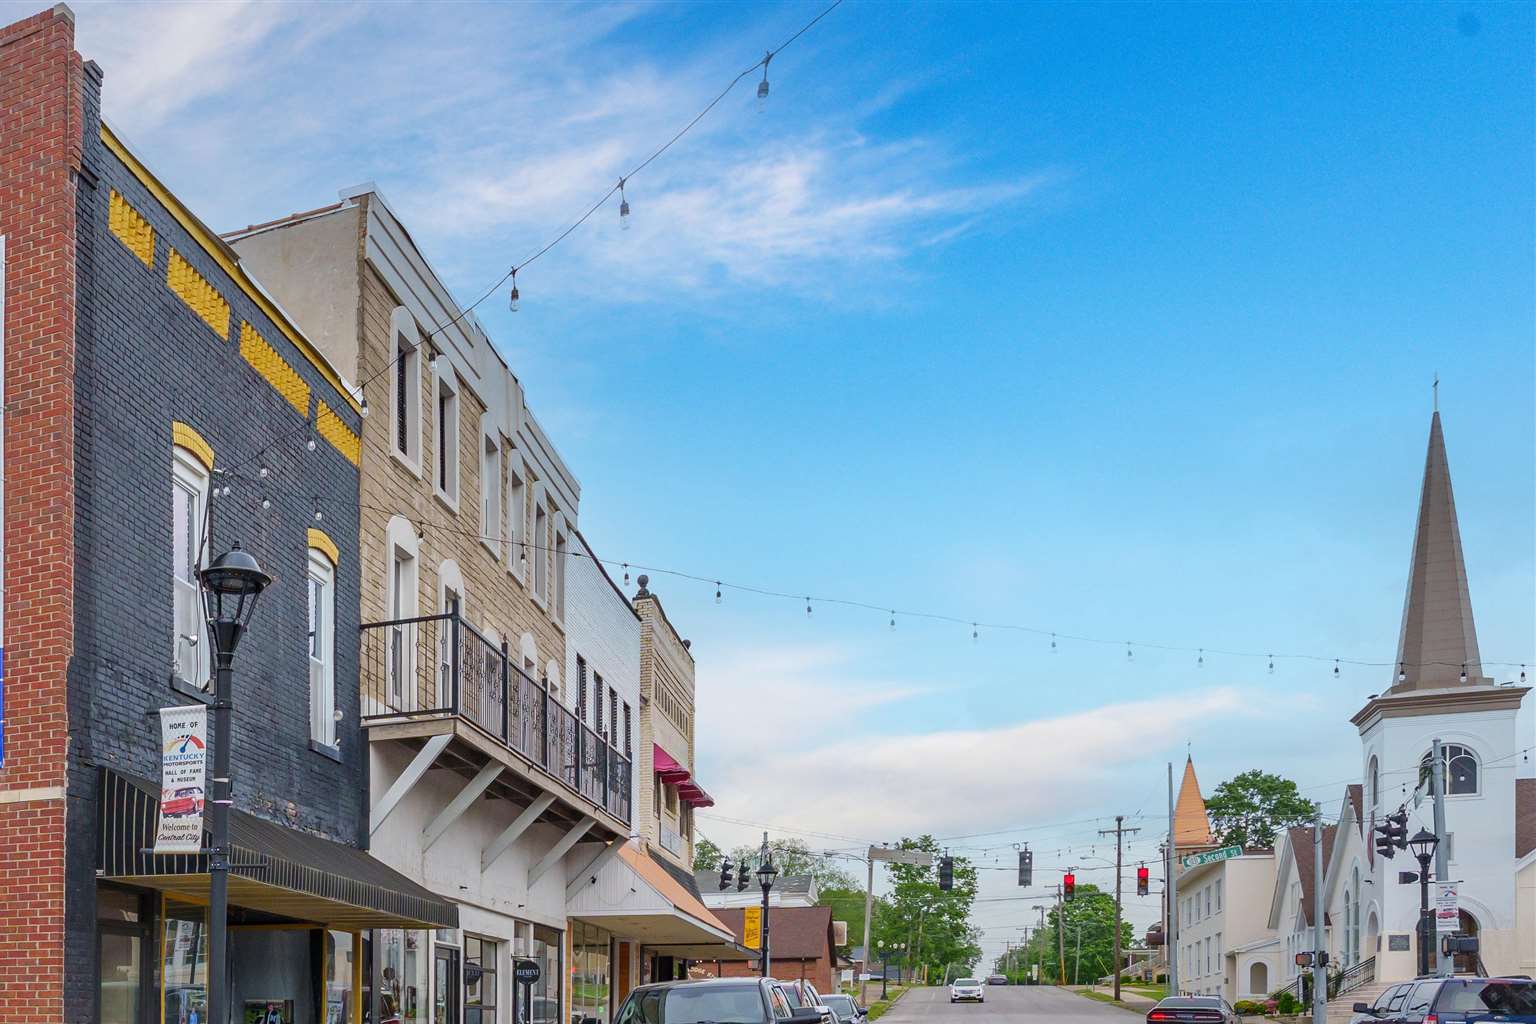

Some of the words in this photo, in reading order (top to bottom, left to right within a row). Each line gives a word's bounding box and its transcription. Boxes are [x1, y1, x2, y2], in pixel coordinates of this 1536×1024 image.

[169, 722, 185, 730] HOME
[163, 753, 204, 761] KENTUCKY
[158, 833, 185, 841] Central
[186, 833, 200, 843] City
[1203, 850, 1227, 863] Second
